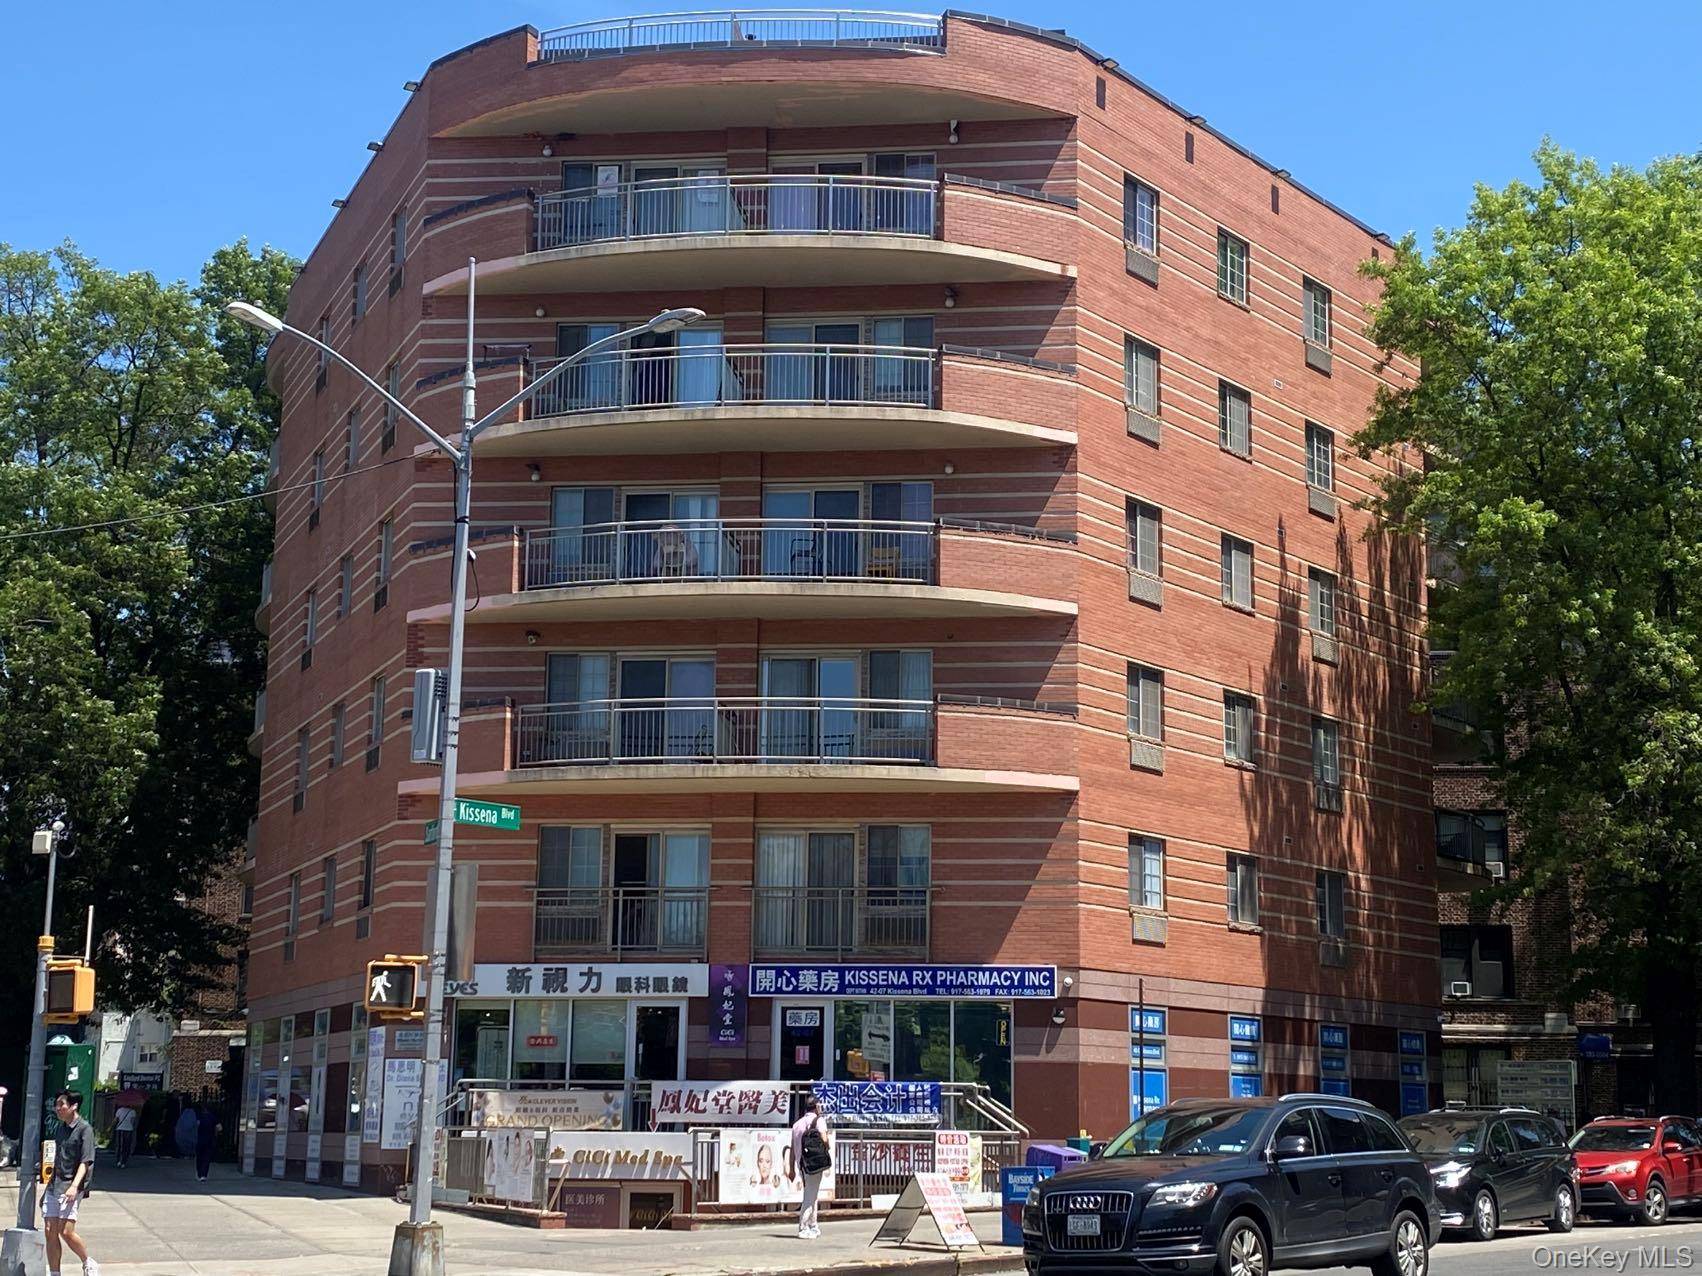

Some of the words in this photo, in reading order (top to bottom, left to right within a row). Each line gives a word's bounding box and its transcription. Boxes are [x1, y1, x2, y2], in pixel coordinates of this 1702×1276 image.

[460, 802, 497, 824] Kissena
[501, 808, 515, 819] Blvd
[506, 967, 602, 994] 新視力
[756, 970, 840, 992] 開心藥房
[845, 970, 909, 985] KISSENA
[912, 970, 933, 985] RX
[936, 970, 1021, 986] PHARMACY
[1024, 971, 1050, 986] INC
[485, 1114, 538, 1127] GRAND
[757, 1133, 775, 1142] Botox
[573, 1150, 610, 1165] CiCi
[614, 1149, 650, 1165] Med
[652, 1151, 683, 1168] Spa
[1008, 1174, 1034, 1184] BAYSIDE
